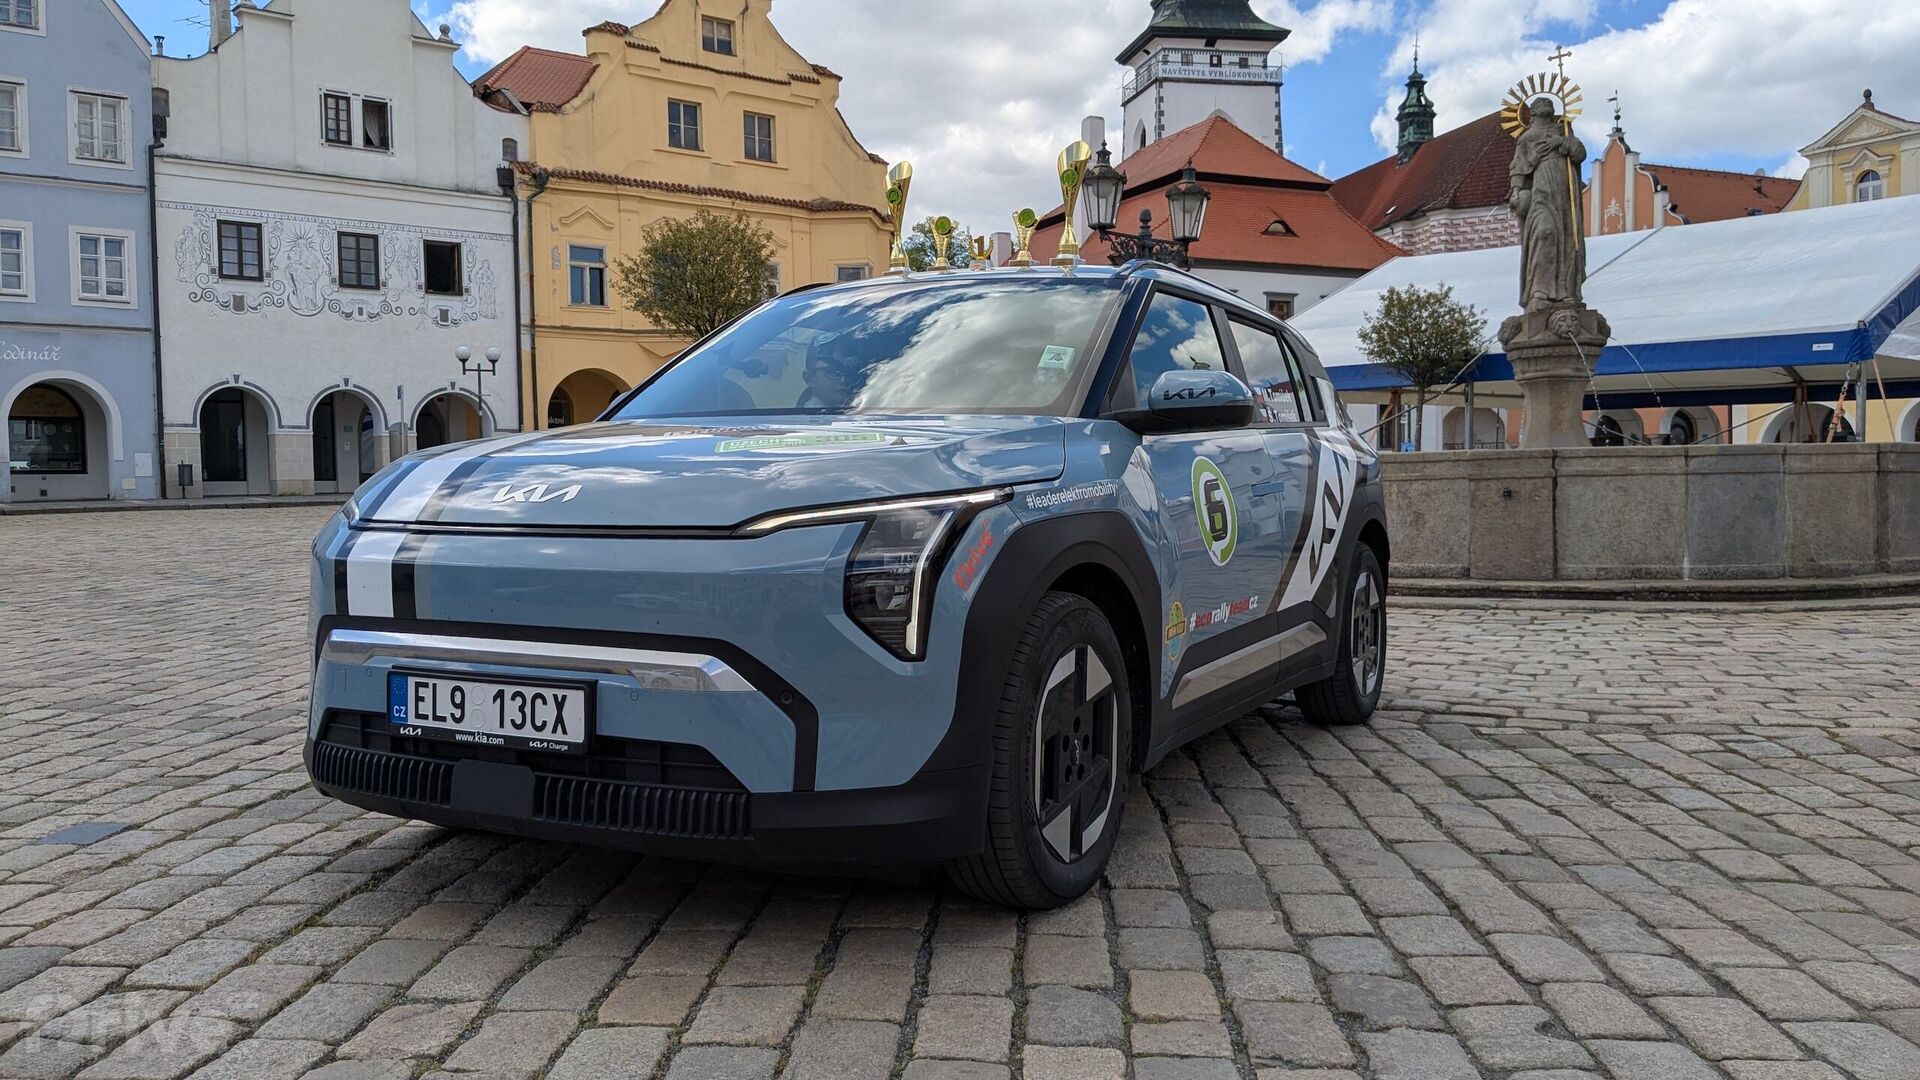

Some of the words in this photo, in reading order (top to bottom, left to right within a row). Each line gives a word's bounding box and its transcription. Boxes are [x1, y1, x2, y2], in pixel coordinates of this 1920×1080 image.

[1161, 67, 1206, 77] NAVŠTIVTE
[1163, 386, 1216, 400] KIA
[492, 484, 583, 503] KIA
[1203, 478, 1228, 542] 6
[393, 705, 406, 718] CZ
[414, 681, 466, 724] EL9
[492, 688, 568, 736] 13CX
[400, 726, 422, 736] KIA
[455, 731, 504, 745] www.kia.com
[549, 742, 568, 751] Charge
